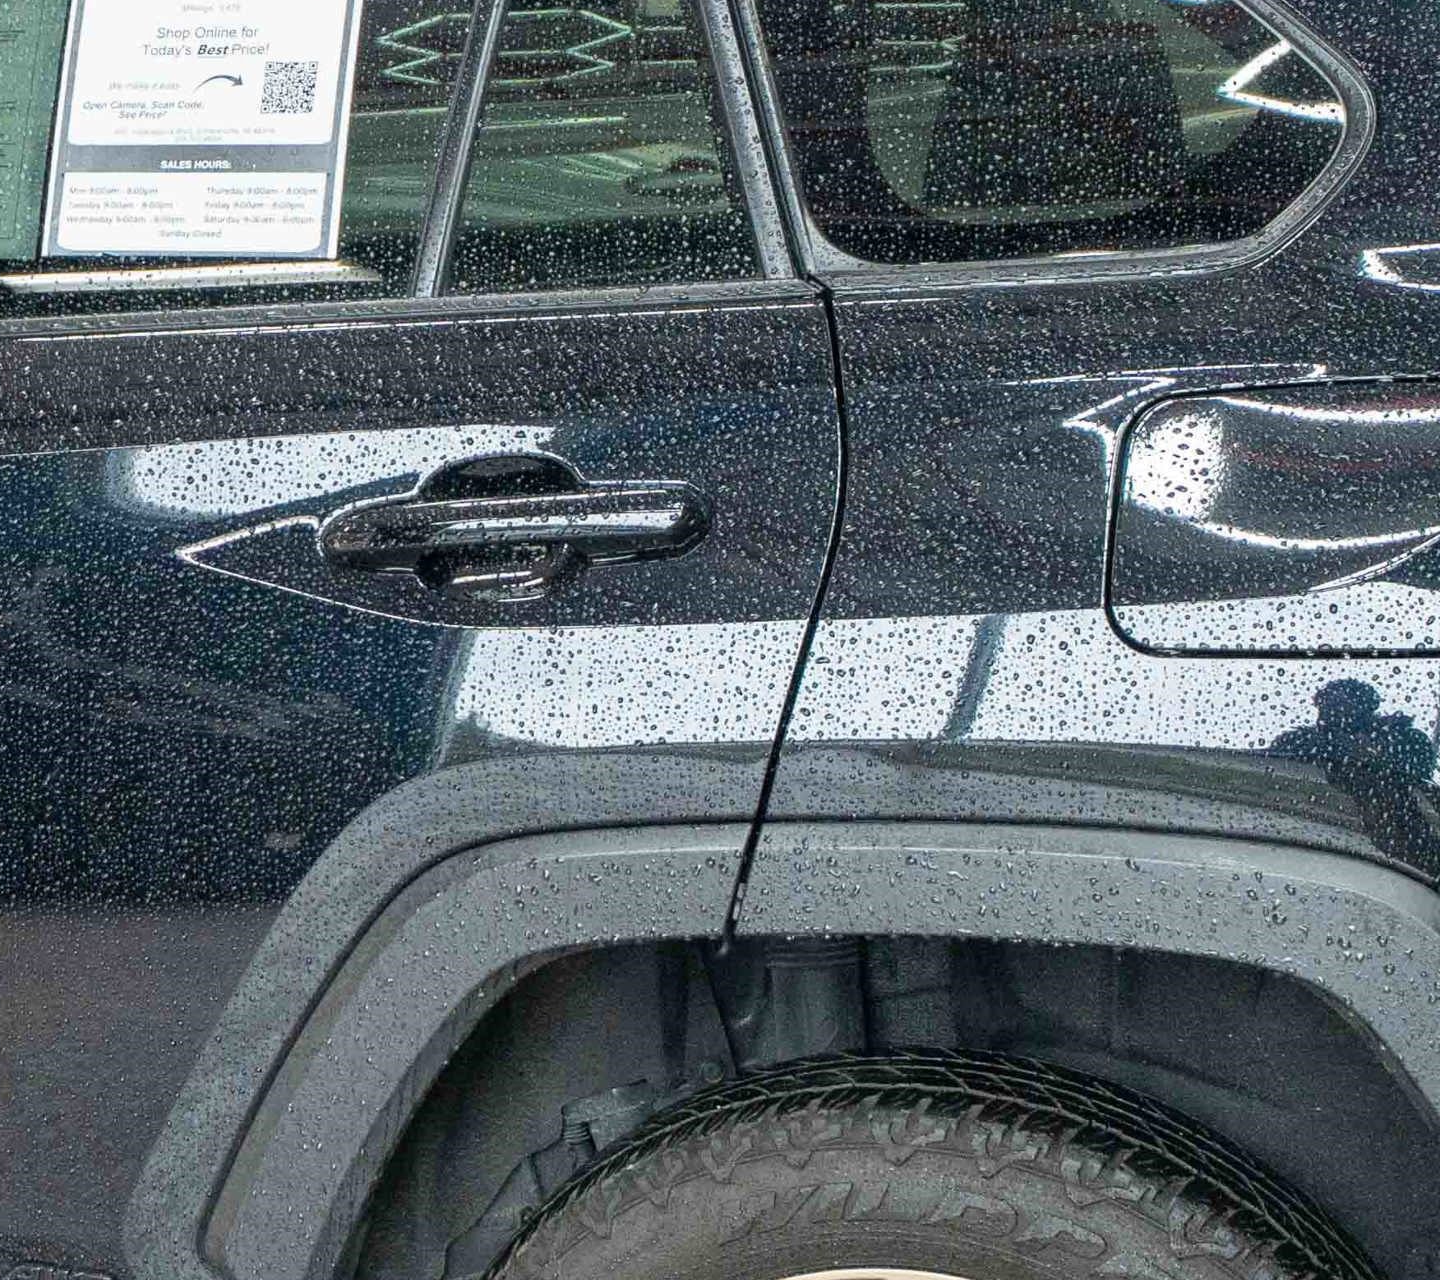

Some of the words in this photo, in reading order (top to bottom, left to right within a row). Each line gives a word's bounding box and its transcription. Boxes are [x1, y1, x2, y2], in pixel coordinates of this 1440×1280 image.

[157, 26, 191, 40] Shop
[194, 26, 238, 39] Online
[241, 25, 258, 38] for
[143, 43, 192, 57] Today's
[197, 43, 229, 56] Best
[230, 42, 270, 56] Price!
[82, 101, 108, 111] Open
[151, 100, 175, 110] Scan
[119, 111, 137, 120] See
[160, 160, 192, 170] SALES
[194, 159, 231, 170] HOURS:
